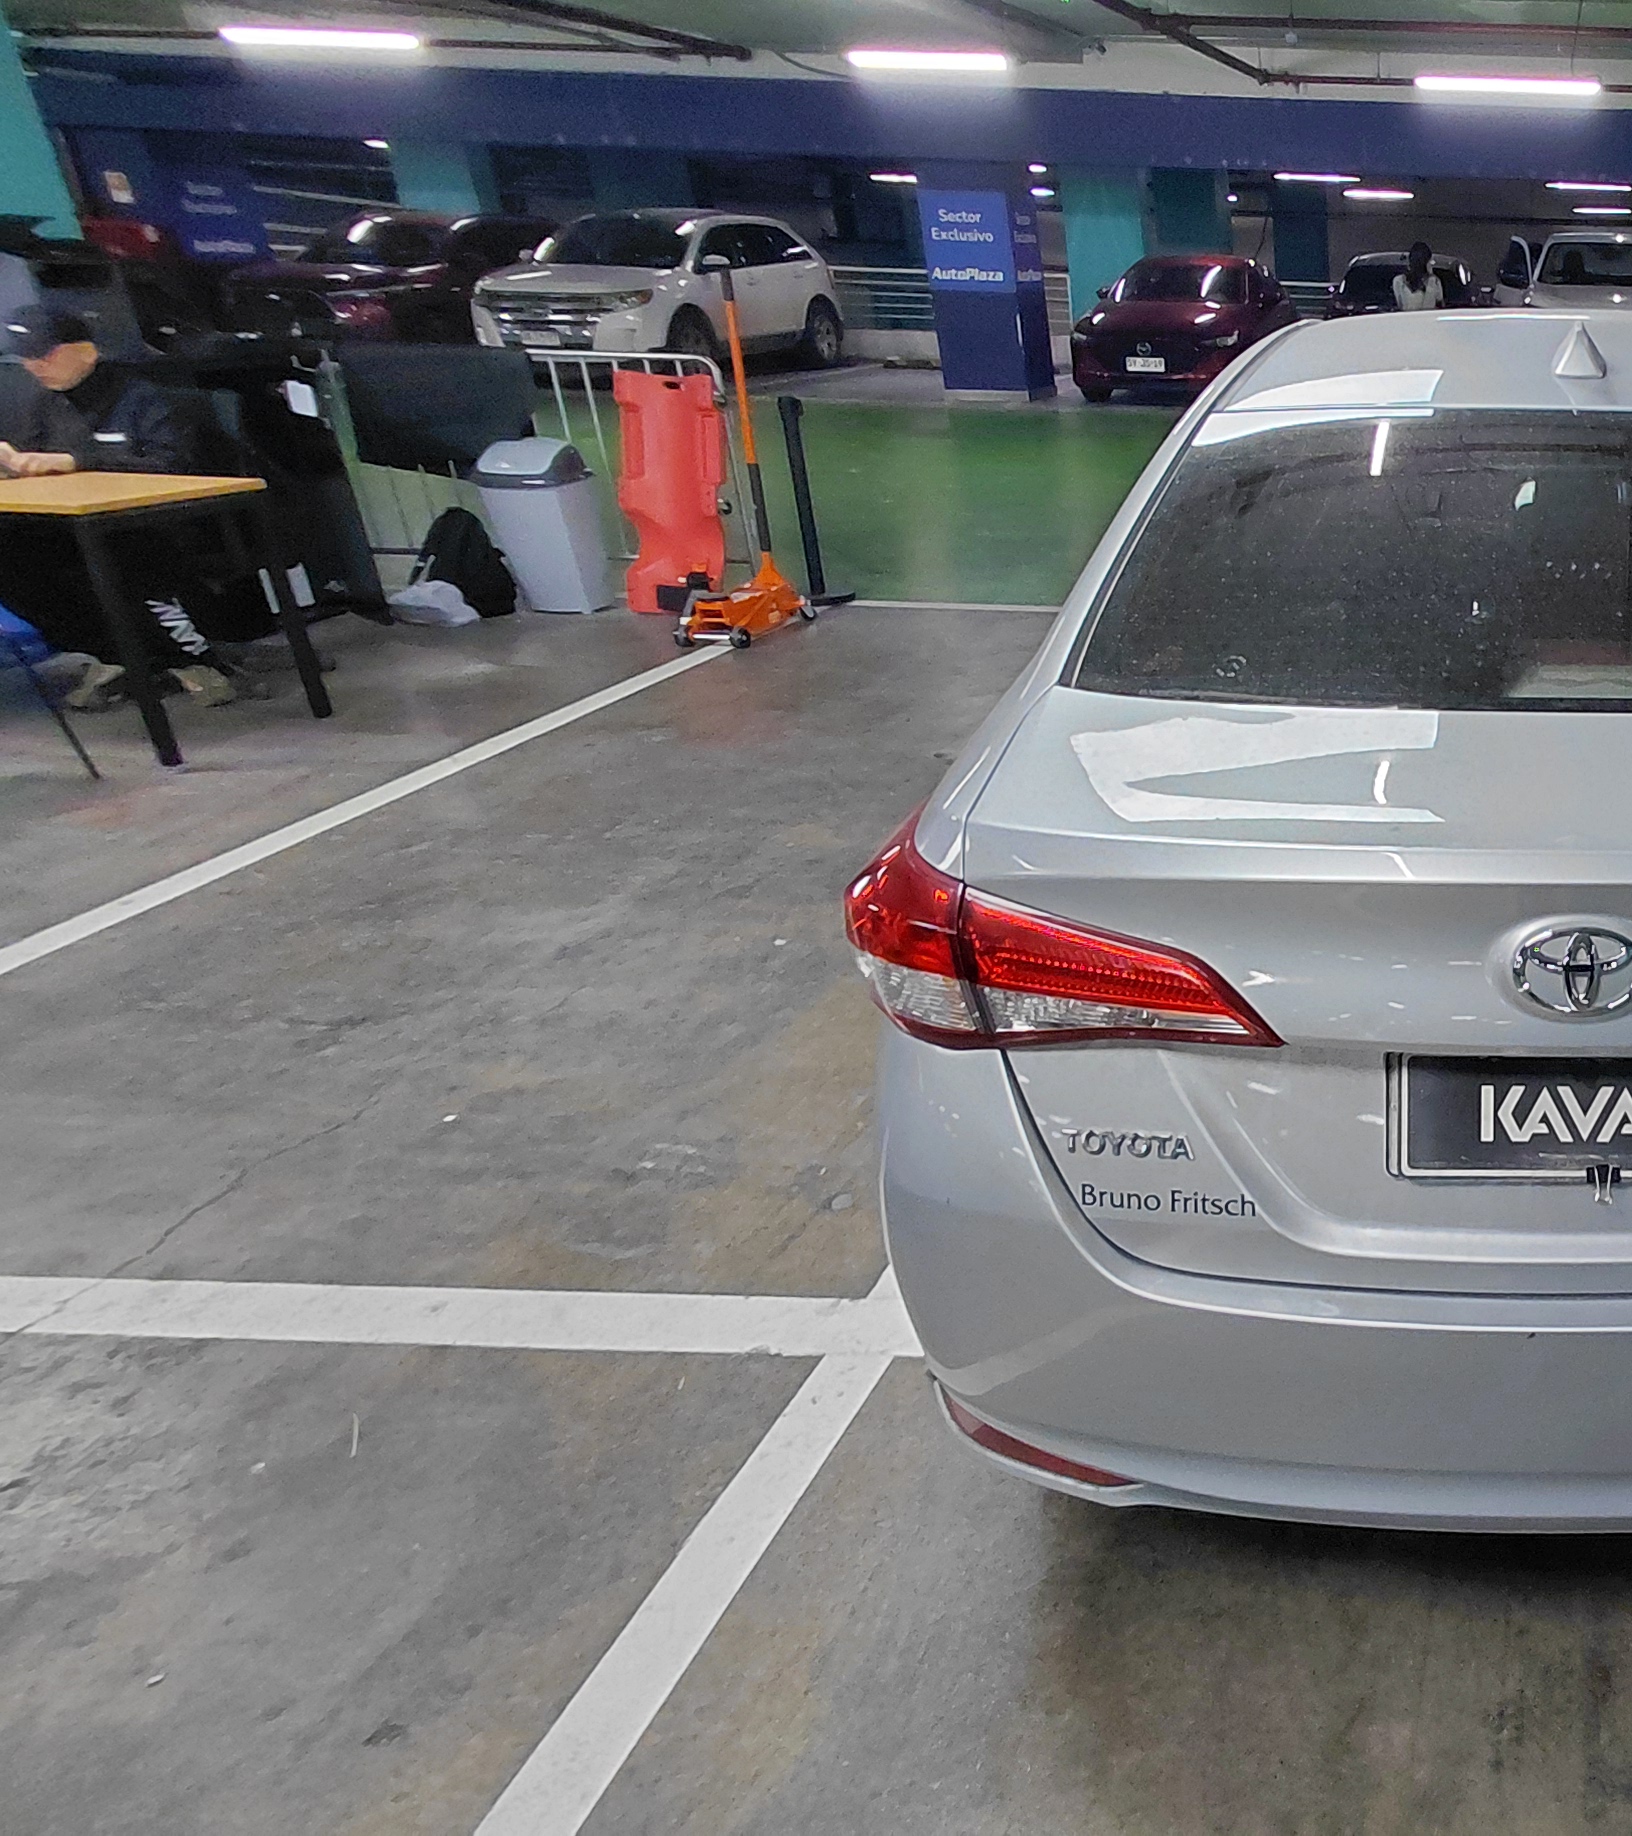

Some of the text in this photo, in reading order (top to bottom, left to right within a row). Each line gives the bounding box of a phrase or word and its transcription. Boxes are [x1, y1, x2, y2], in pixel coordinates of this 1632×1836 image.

[938, 209, 981, 223] Sector
[931, 227, 994, 242] Exclusivo
[931, 267, 1004, 281] AutoPlaza
[1061, 1128, 1196, 1160] TOYOTA
[1081, 1183, 1257, 1217] Bruno Fritsch
